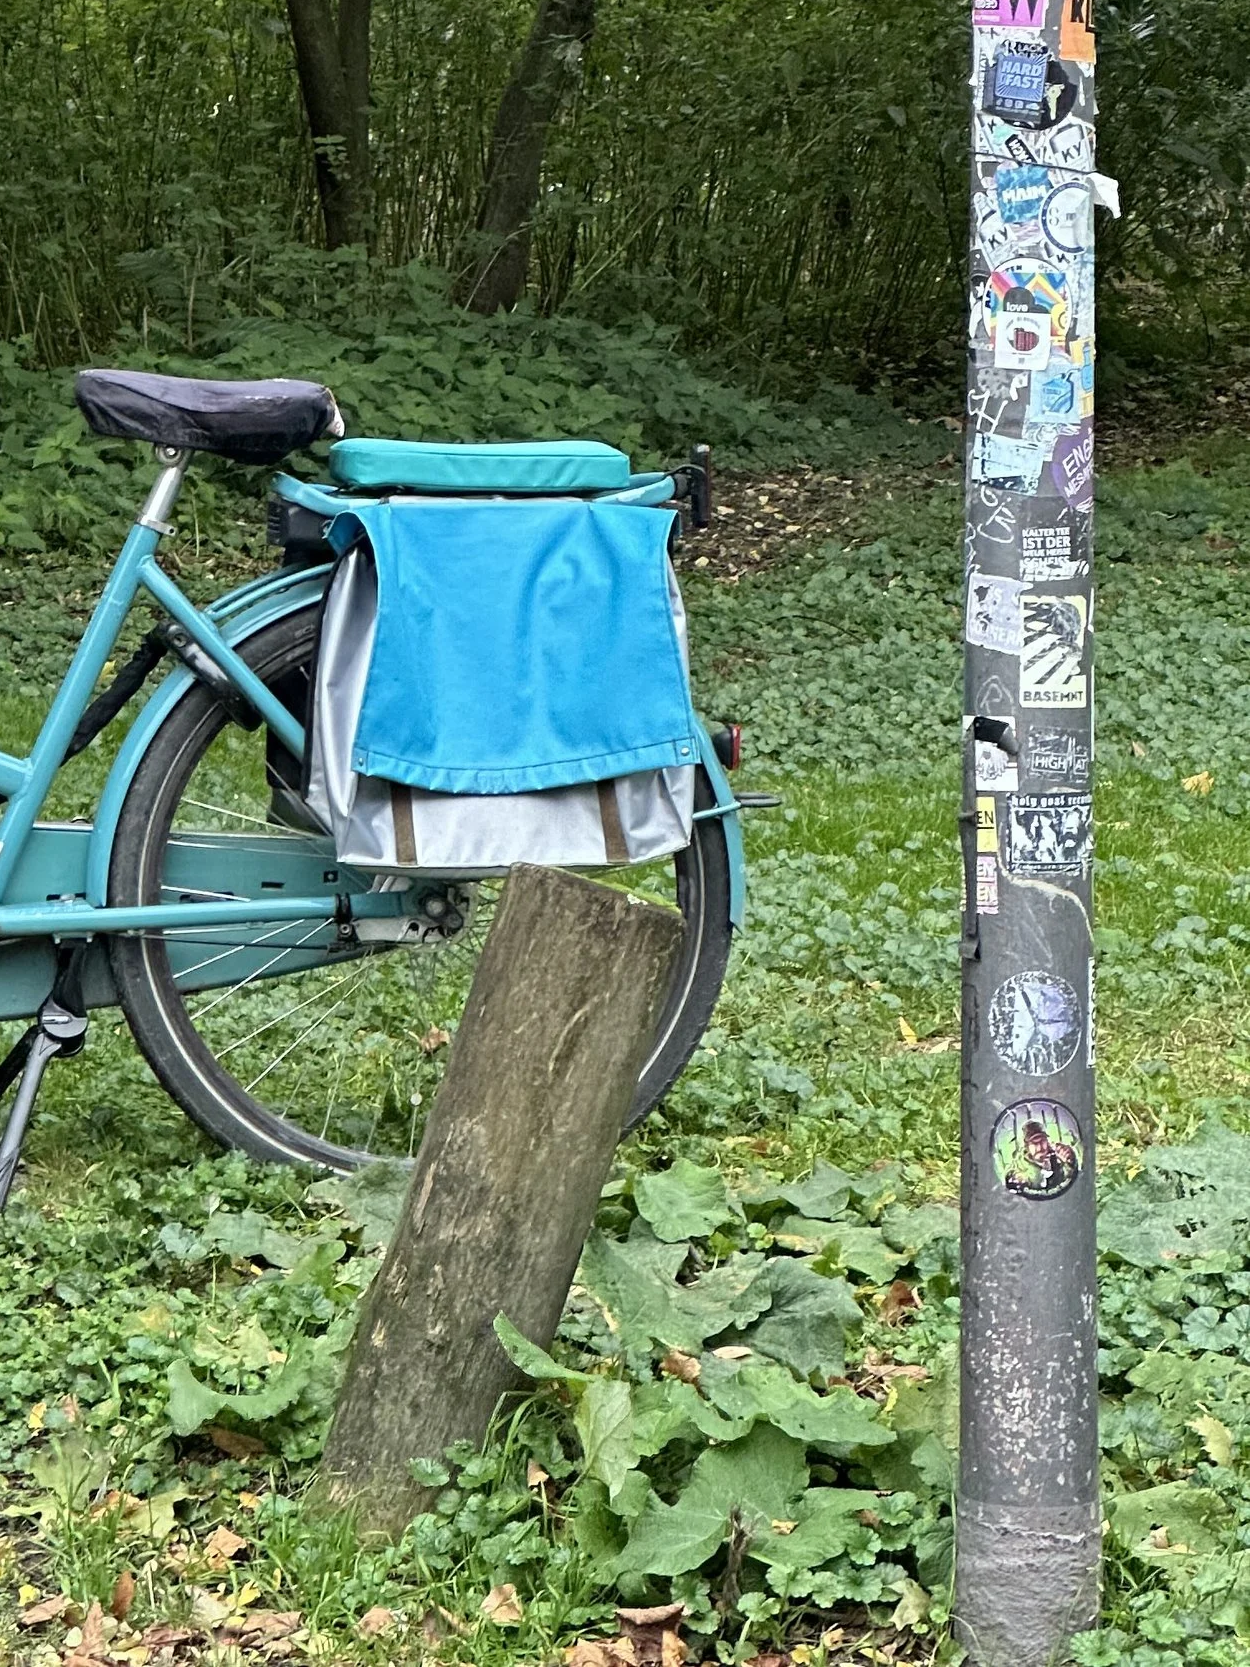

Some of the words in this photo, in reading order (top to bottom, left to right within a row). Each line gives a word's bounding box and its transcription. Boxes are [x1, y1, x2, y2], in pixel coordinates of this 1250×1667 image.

[1001, 60, 1043, 77] HARD
[1022, 537, 1044, 550] IST
[1045, 536, 1071, 549] DER
